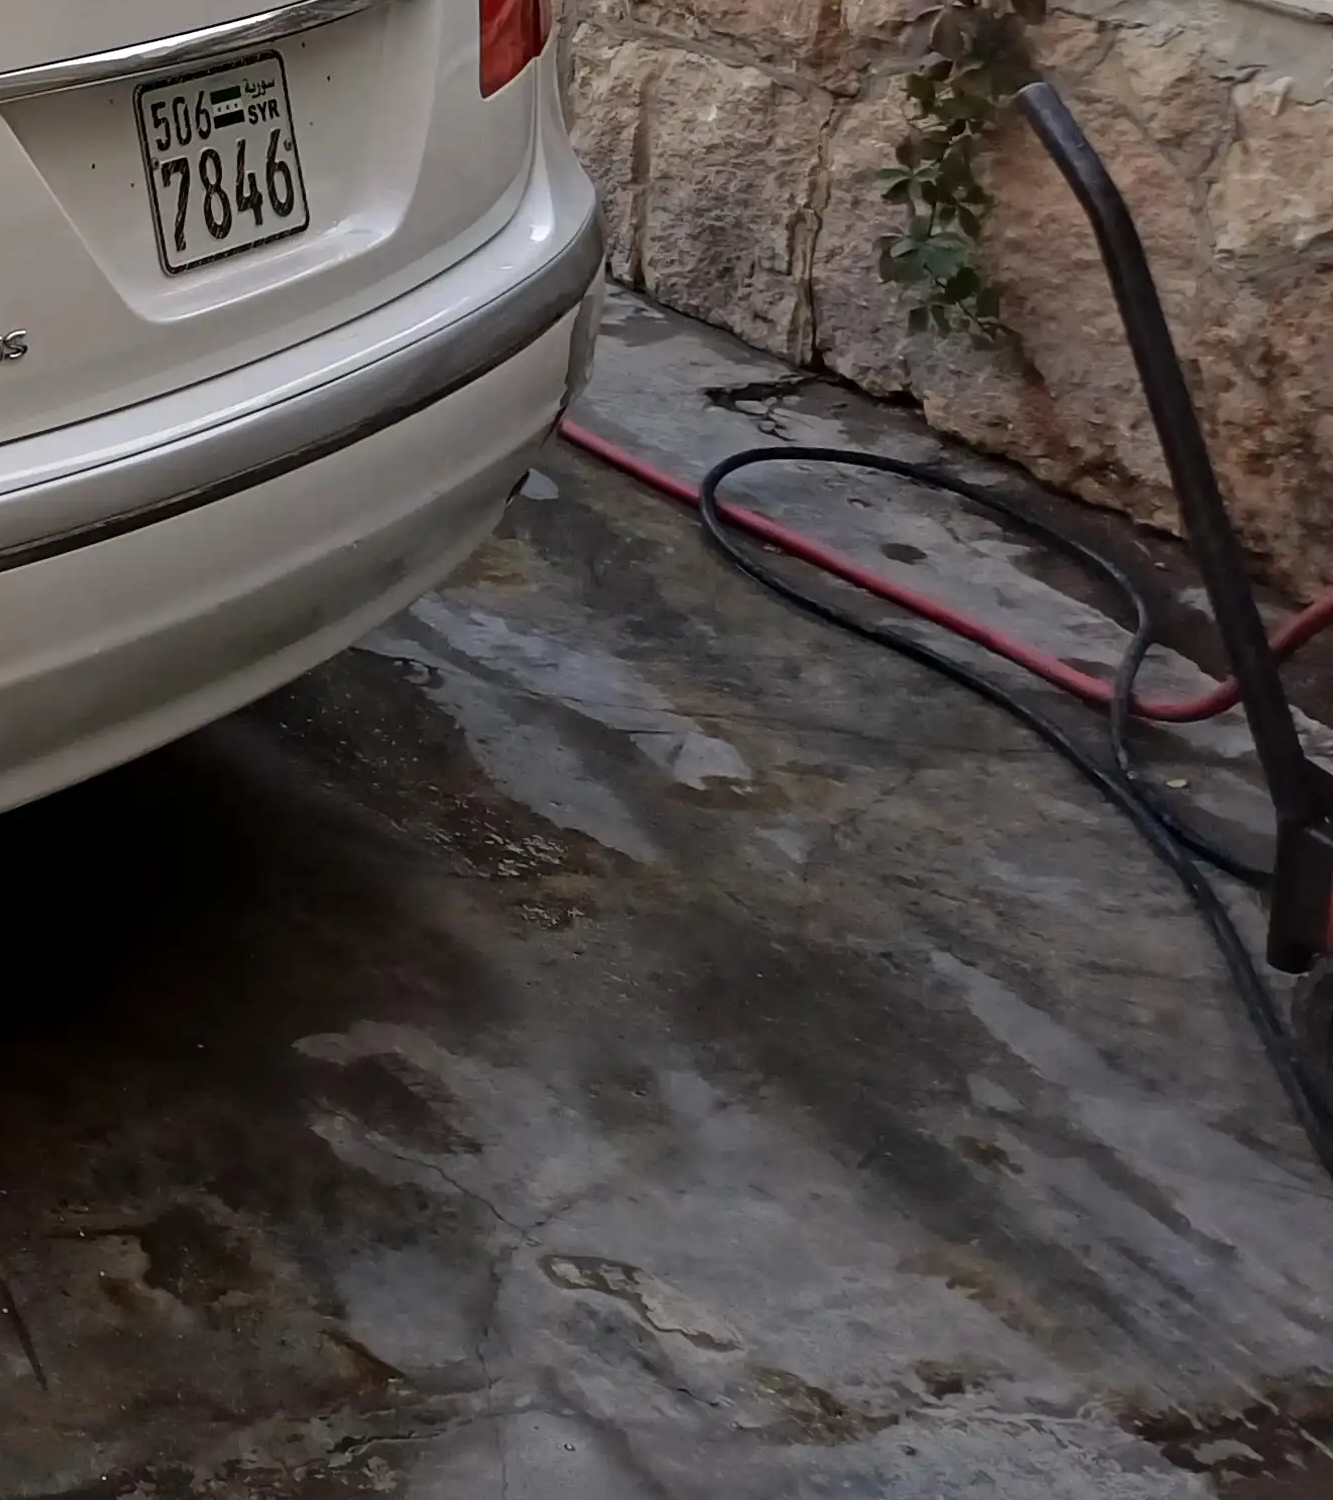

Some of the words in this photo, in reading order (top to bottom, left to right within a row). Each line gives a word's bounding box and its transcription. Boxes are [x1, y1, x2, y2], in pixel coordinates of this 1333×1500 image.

[243, 78, 276, 98] سورية
[150, 90, 212, 151] 506
[247, 98, 281, 125] SYR
[160, 128, 295, 252] 7846
